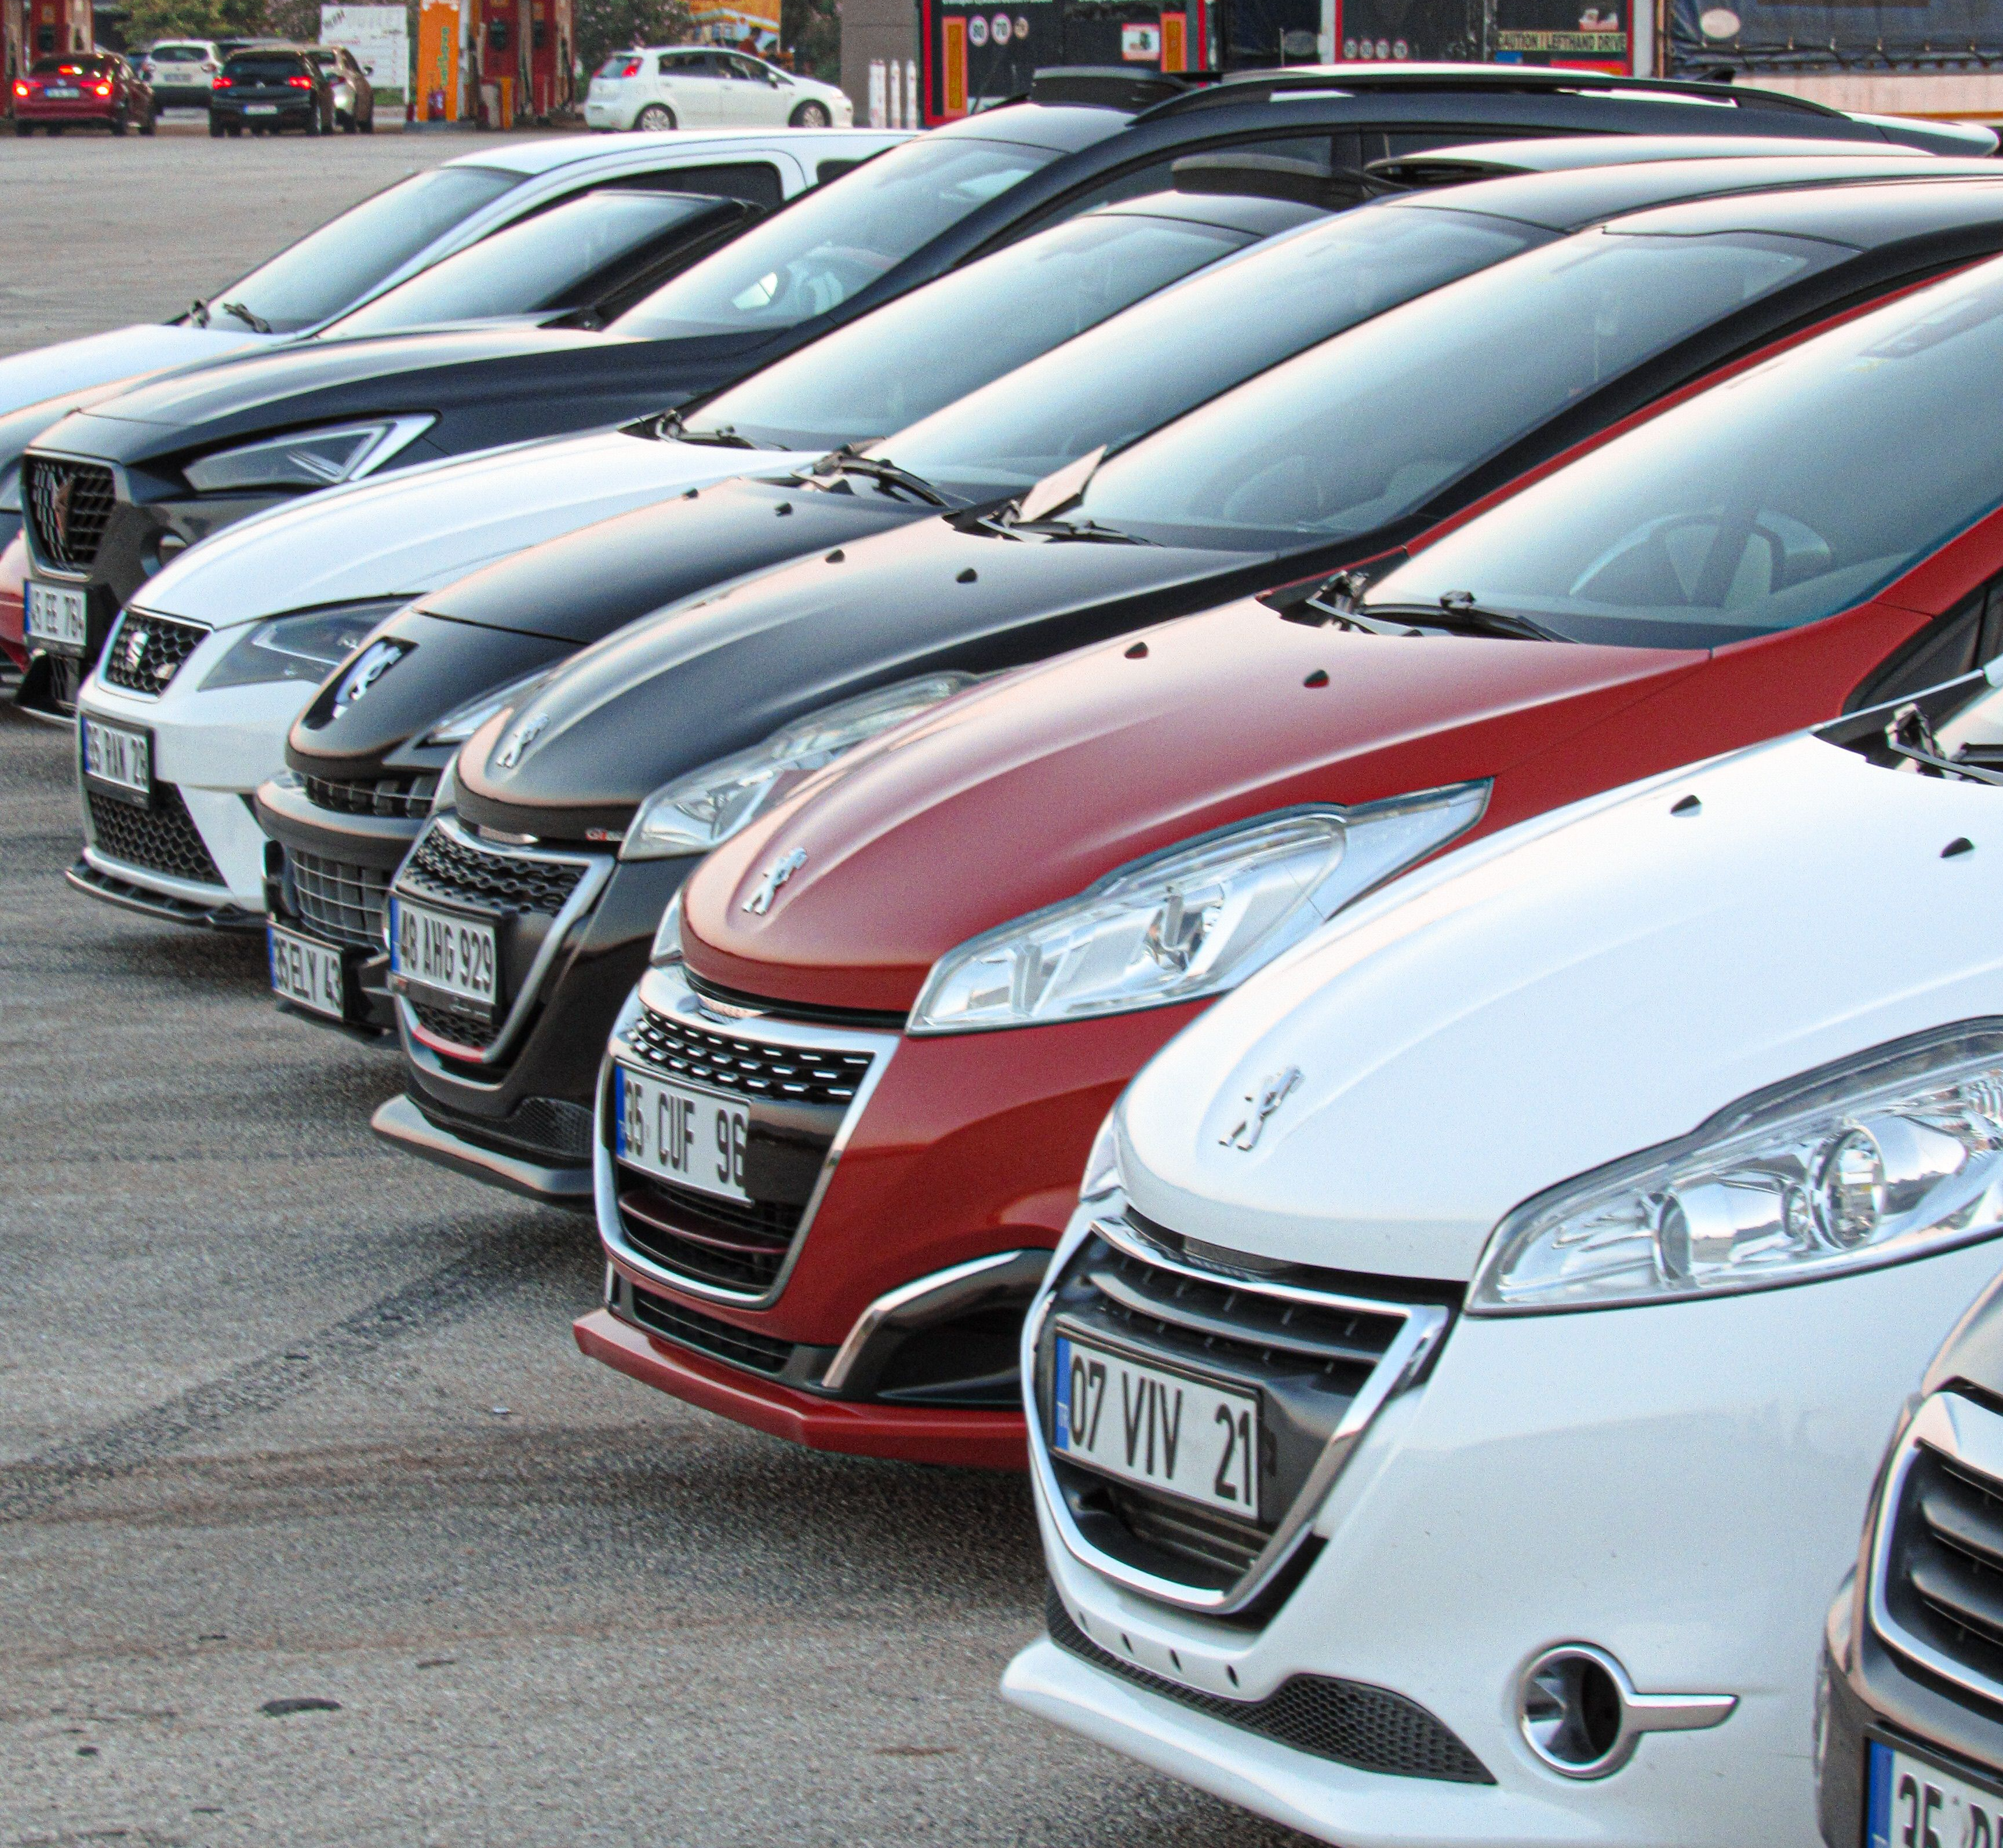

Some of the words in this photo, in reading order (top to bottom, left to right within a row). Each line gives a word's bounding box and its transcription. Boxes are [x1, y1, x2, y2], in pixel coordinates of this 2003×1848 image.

[1498, 32, 1538, 50] CAUTION
[400, 909, 417, 969] 48
[424, 914, 455, 982] AHG
[460, 925, 493, 994] 929
[625, 1078, 644, 1157] 35
[659, 1091, 695, 1174] CUF
[717, 1107, 748, 1187] 96
[1072, 1354, 1107, 1452] 07
[1122, 1369, 1183, 1480] VIV
[1213, 1403, 1252, 1507] 21
